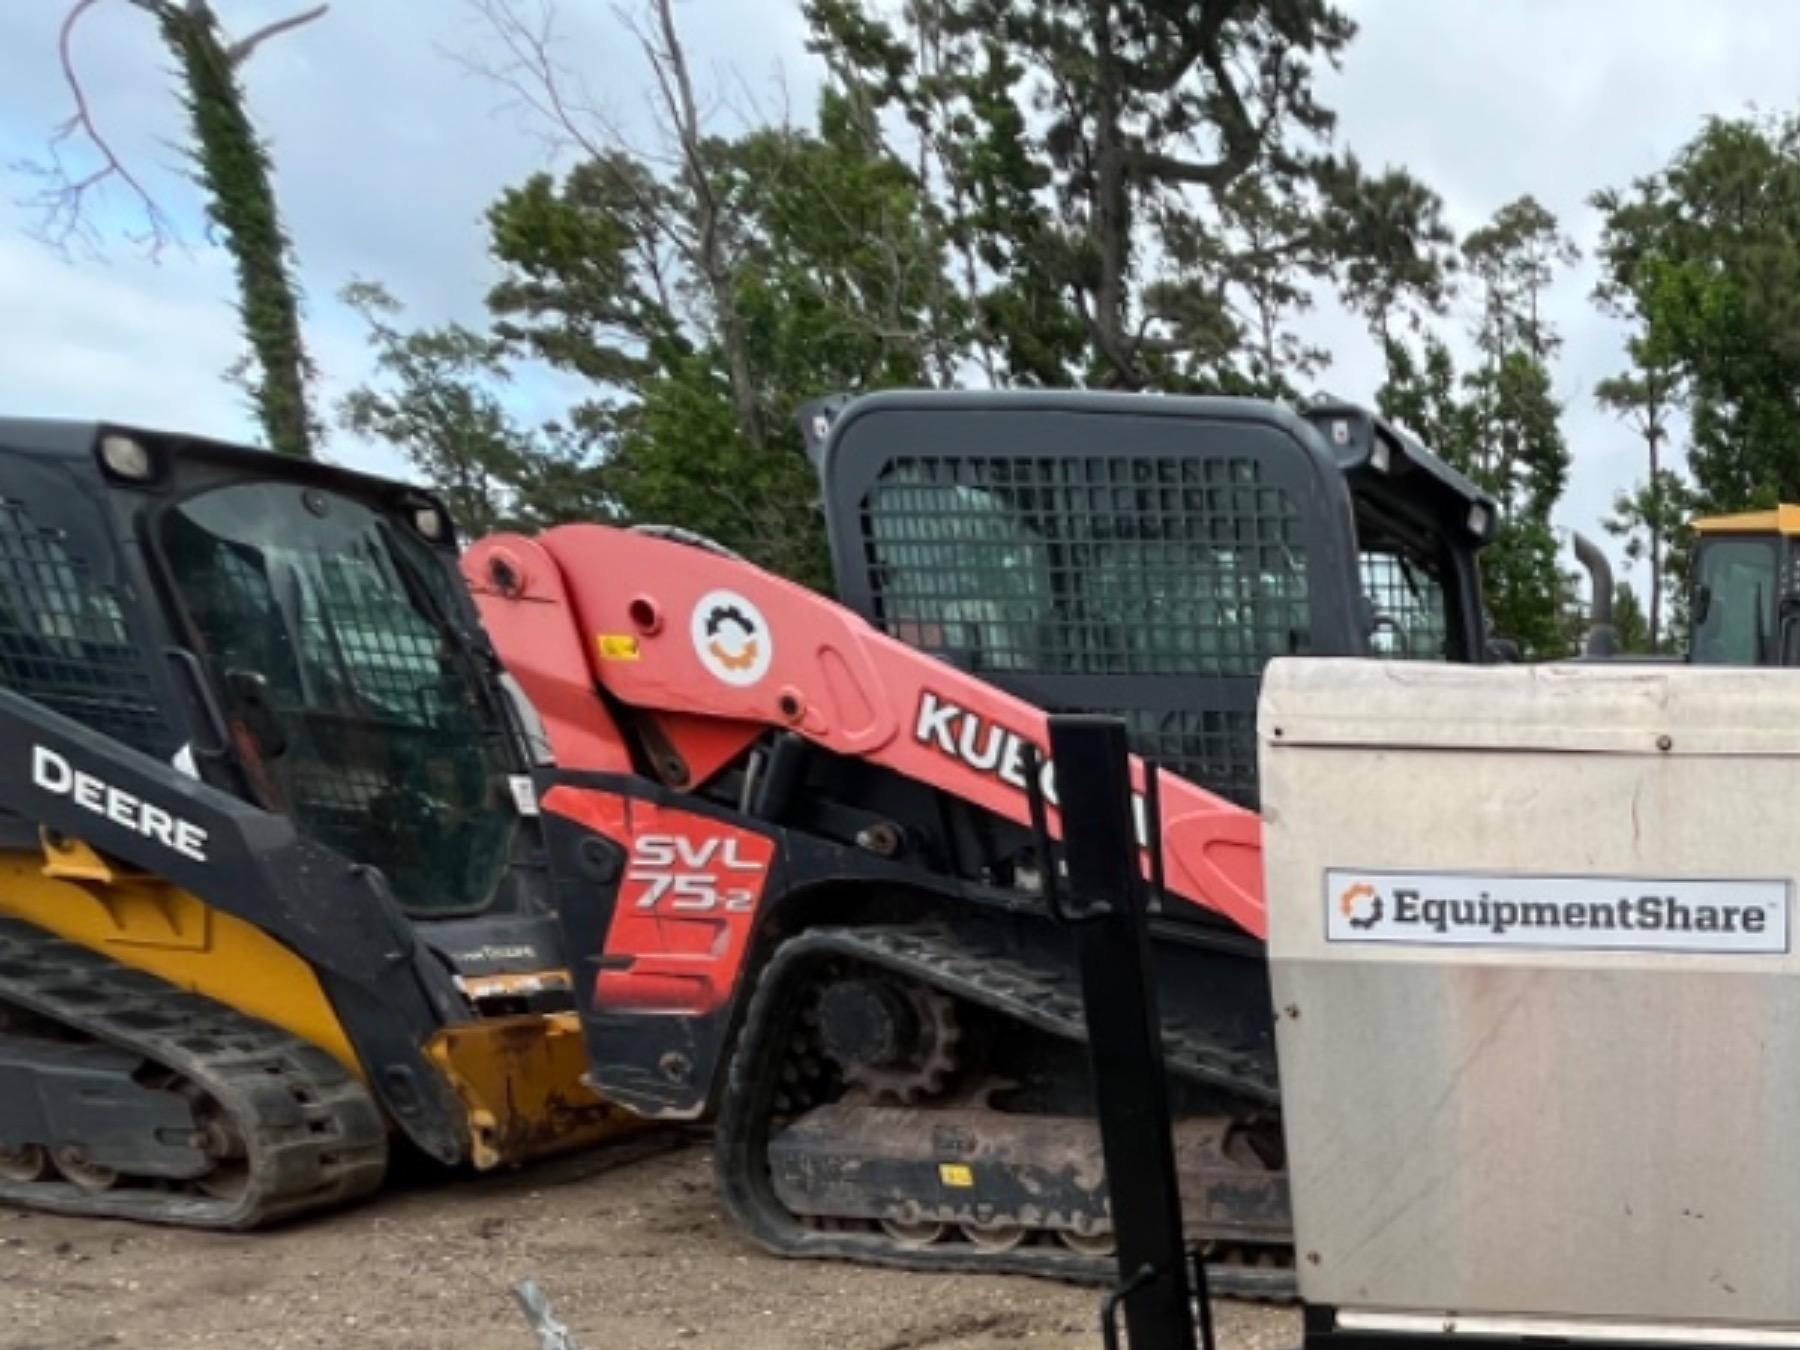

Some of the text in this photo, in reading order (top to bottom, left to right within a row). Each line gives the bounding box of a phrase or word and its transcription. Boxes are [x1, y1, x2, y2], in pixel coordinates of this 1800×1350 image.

[32, 743, 209, 862] DEERE
[631, 834, 763, 868] SVL
[1392, 889, 1767, 934] EquipmentShare
